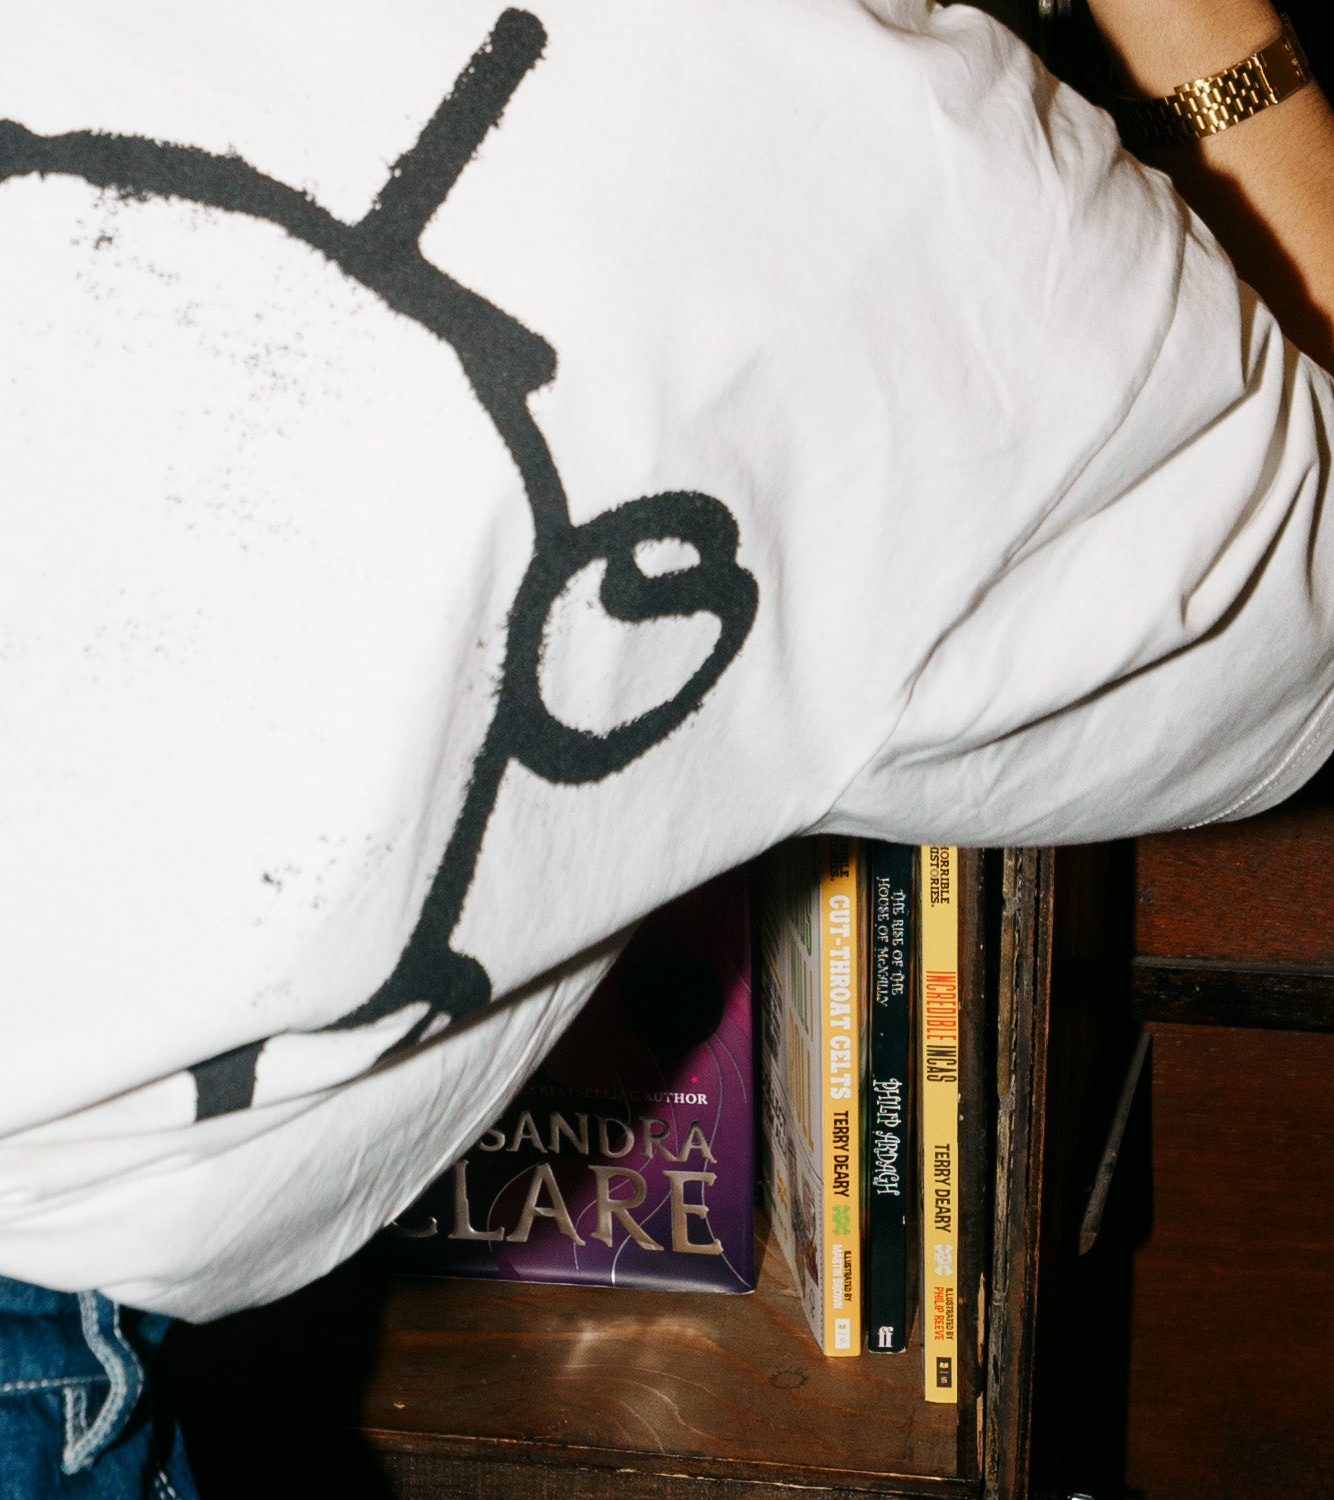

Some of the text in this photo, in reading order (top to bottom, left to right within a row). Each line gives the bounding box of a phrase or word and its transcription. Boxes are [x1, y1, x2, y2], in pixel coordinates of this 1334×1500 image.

[828, 894, 851, 1030] CUT-THROAT
[830, 1035, 851, 1100] CELTS
[926, 970, 957, 1084] INCREDIBLE INCAS
[833, 1111, 849, 1197] TERRY DEARY
[873, 1077, 903, 1197] PHILIP ARDAGH
[392, 1160, 724, 1255] LARE
[934, 1144, 951, 1233] TERRY DEARY
